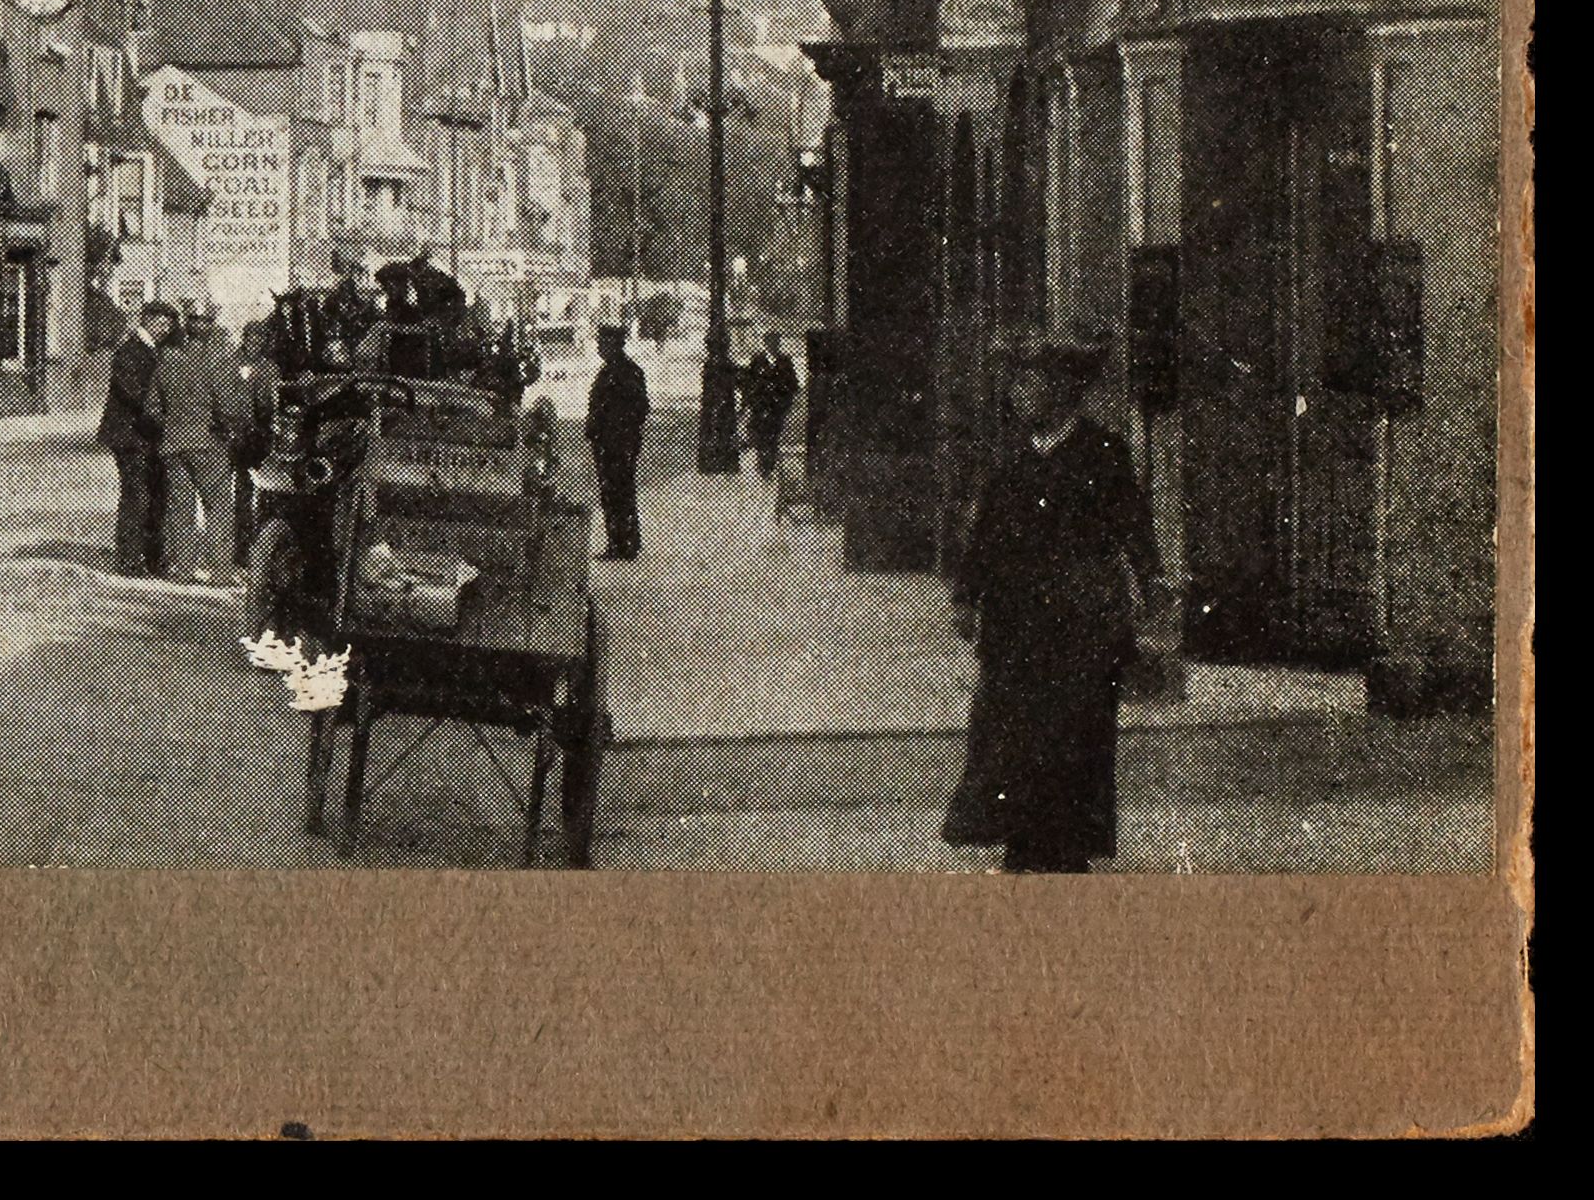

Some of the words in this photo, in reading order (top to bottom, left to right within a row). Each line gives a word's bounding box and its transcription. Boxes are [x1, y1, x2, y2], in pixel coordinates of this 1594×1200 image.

[161, 107, 236, 128] FISHER
[190, 129, 275, 149] MILLER
[201, 152, 280, 172] CORN
[204, 176, 280, 196] COAL
[213, 200, 280, 219] SEED
